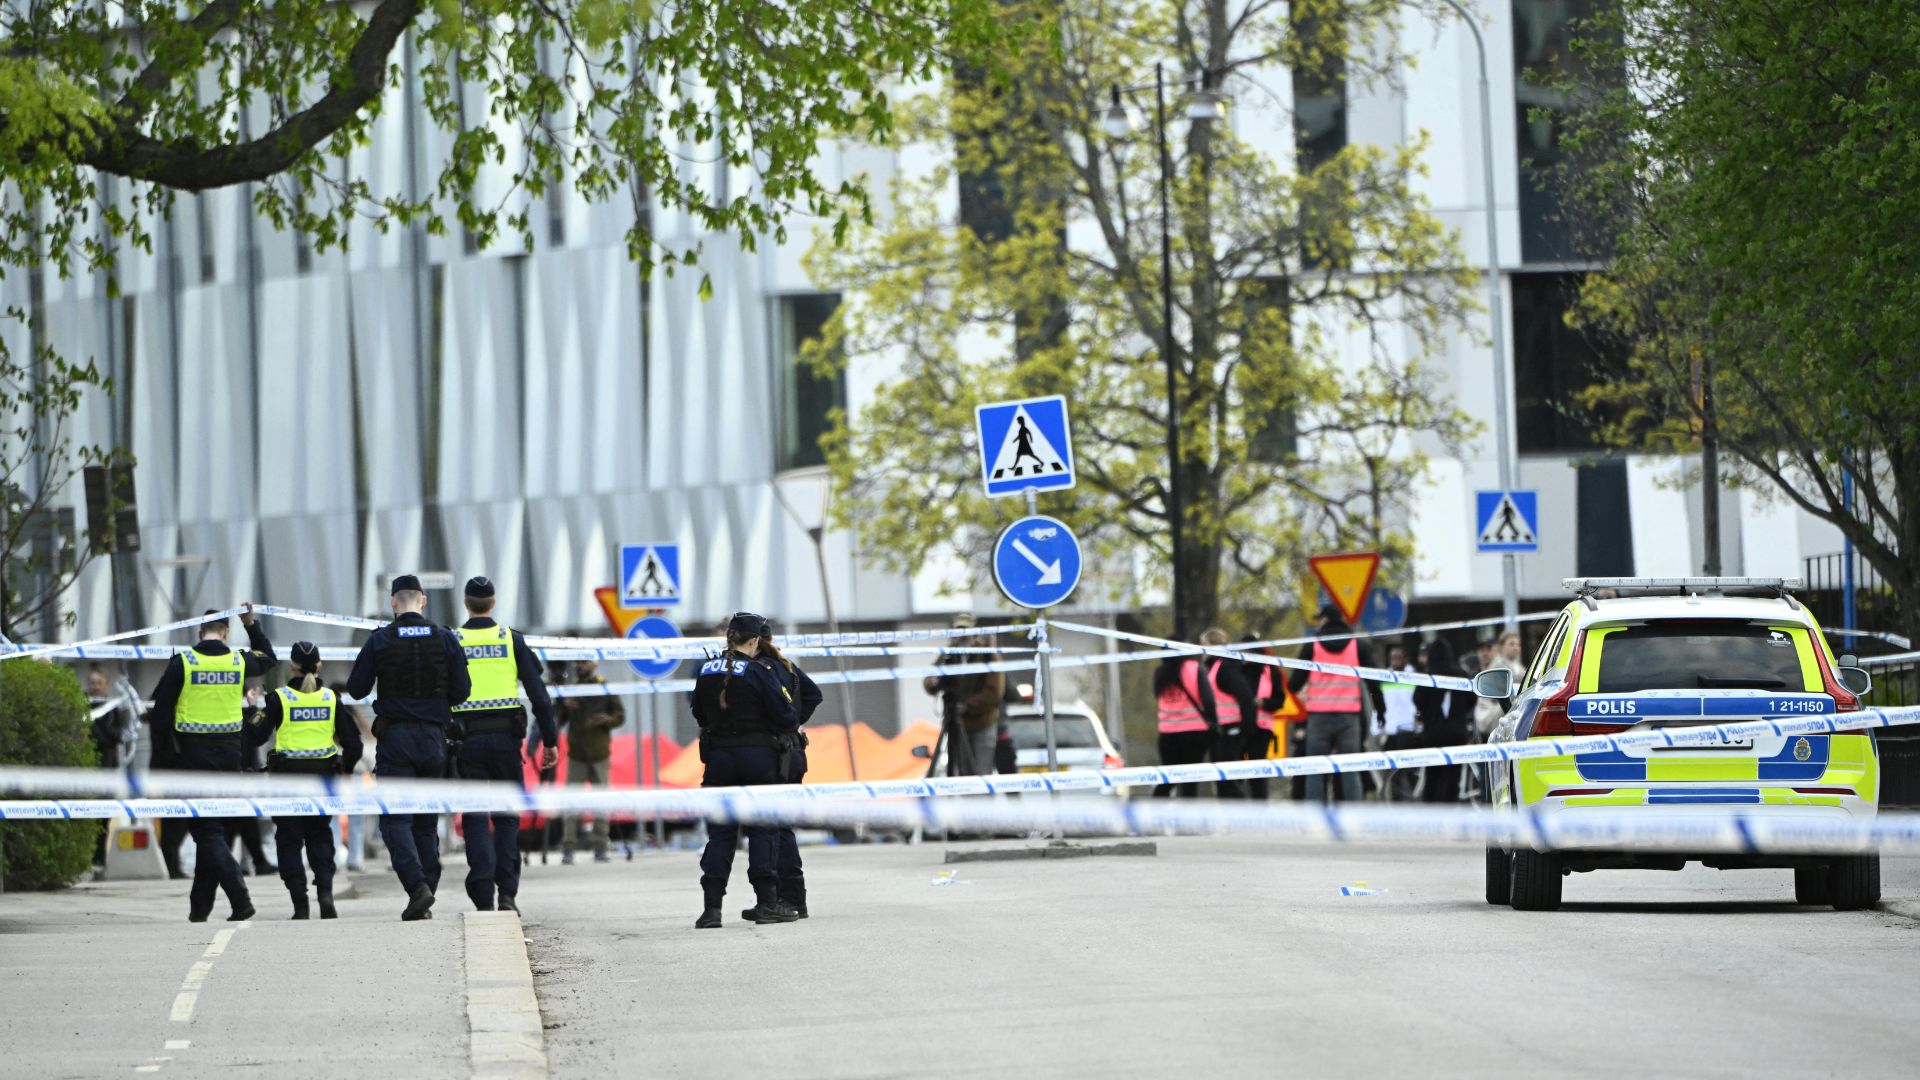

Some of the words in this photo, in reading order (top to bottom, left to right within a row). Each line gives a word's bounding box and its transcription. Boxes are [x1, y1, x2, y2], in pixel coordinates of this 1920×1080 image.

[398, 626, 431, 637] POLIS
[465, 645, 503, 658] POLIS
[197, 671, 236, 684] POLIS
[1586, 700, 1636, 715] POLIS
[1769, 701, 1775, 712] 1
[1780, 701, 1824, 713] 21-1150
[292, 708, 328, 720] POLIS
